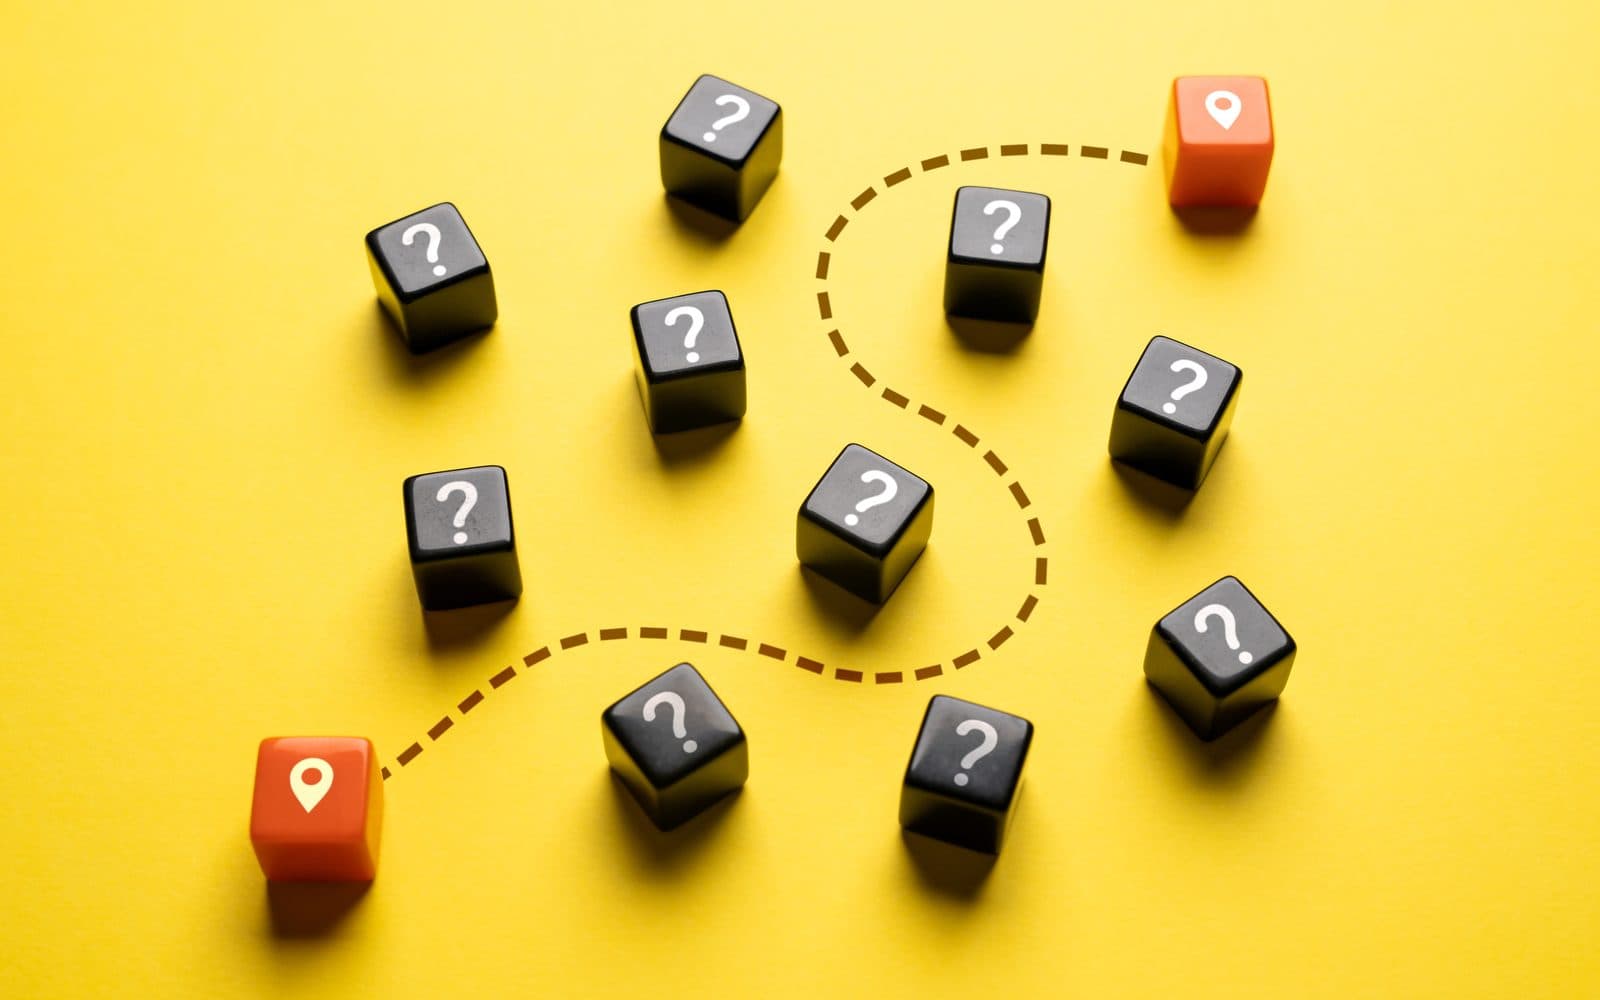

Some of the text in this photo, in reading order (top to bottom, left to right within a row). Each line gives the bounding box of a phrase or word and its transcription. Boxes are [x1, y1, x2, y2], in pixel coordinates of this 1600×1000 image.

[703, 95, 750, 142] ?
[402, 223, 445, 276] ?
[984, 200, 1021, 254] ?
[665, 306, 704, 363] ?
[1163, 360, 1207, 414] ?
[437, 481, 477, 544] ?
[845, 470, 897, 525] ?
[1195, 604, 1252, 664] ?
[643, 691, 697, 752] ?
[955, 719, 998, 785] ?
